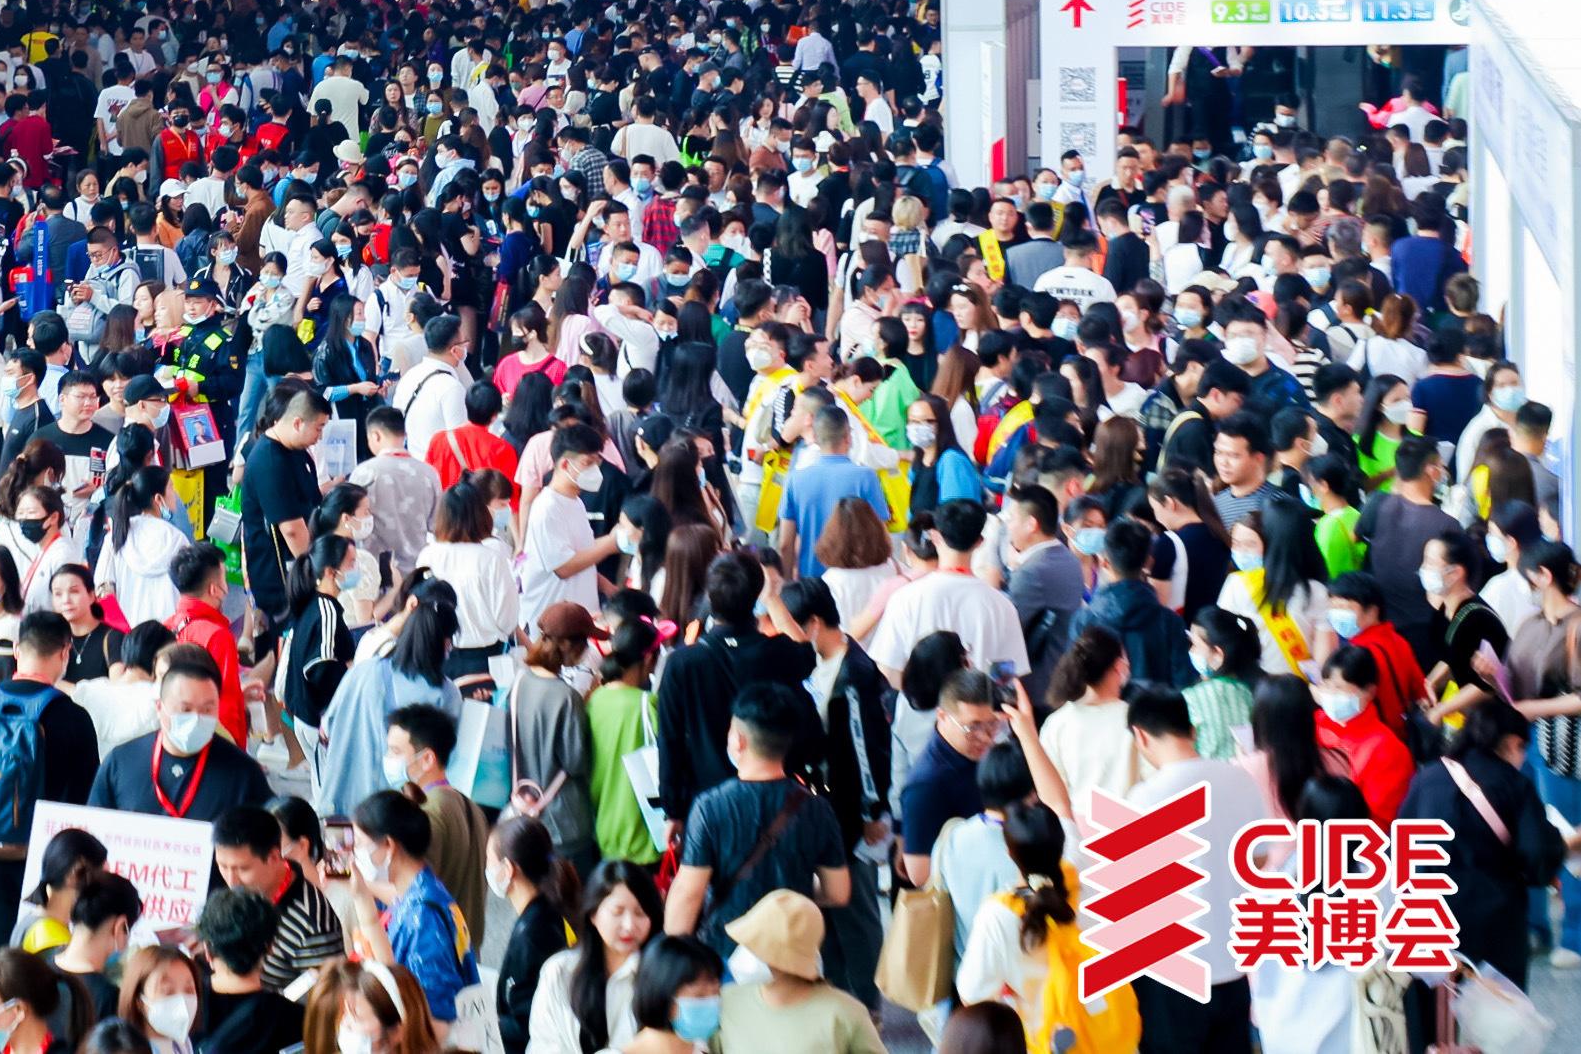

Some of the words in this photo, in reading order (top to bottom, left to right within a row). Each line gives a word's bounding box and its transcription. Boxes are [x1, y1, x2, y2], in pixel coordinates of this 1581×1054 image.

[1150, 2, 1186, 13] CIBE
[1214, 2, 1249, 22] 9.3
[1366, 1, 1413, 20] 11.3
[106, 859, 198, 893] EM代工
